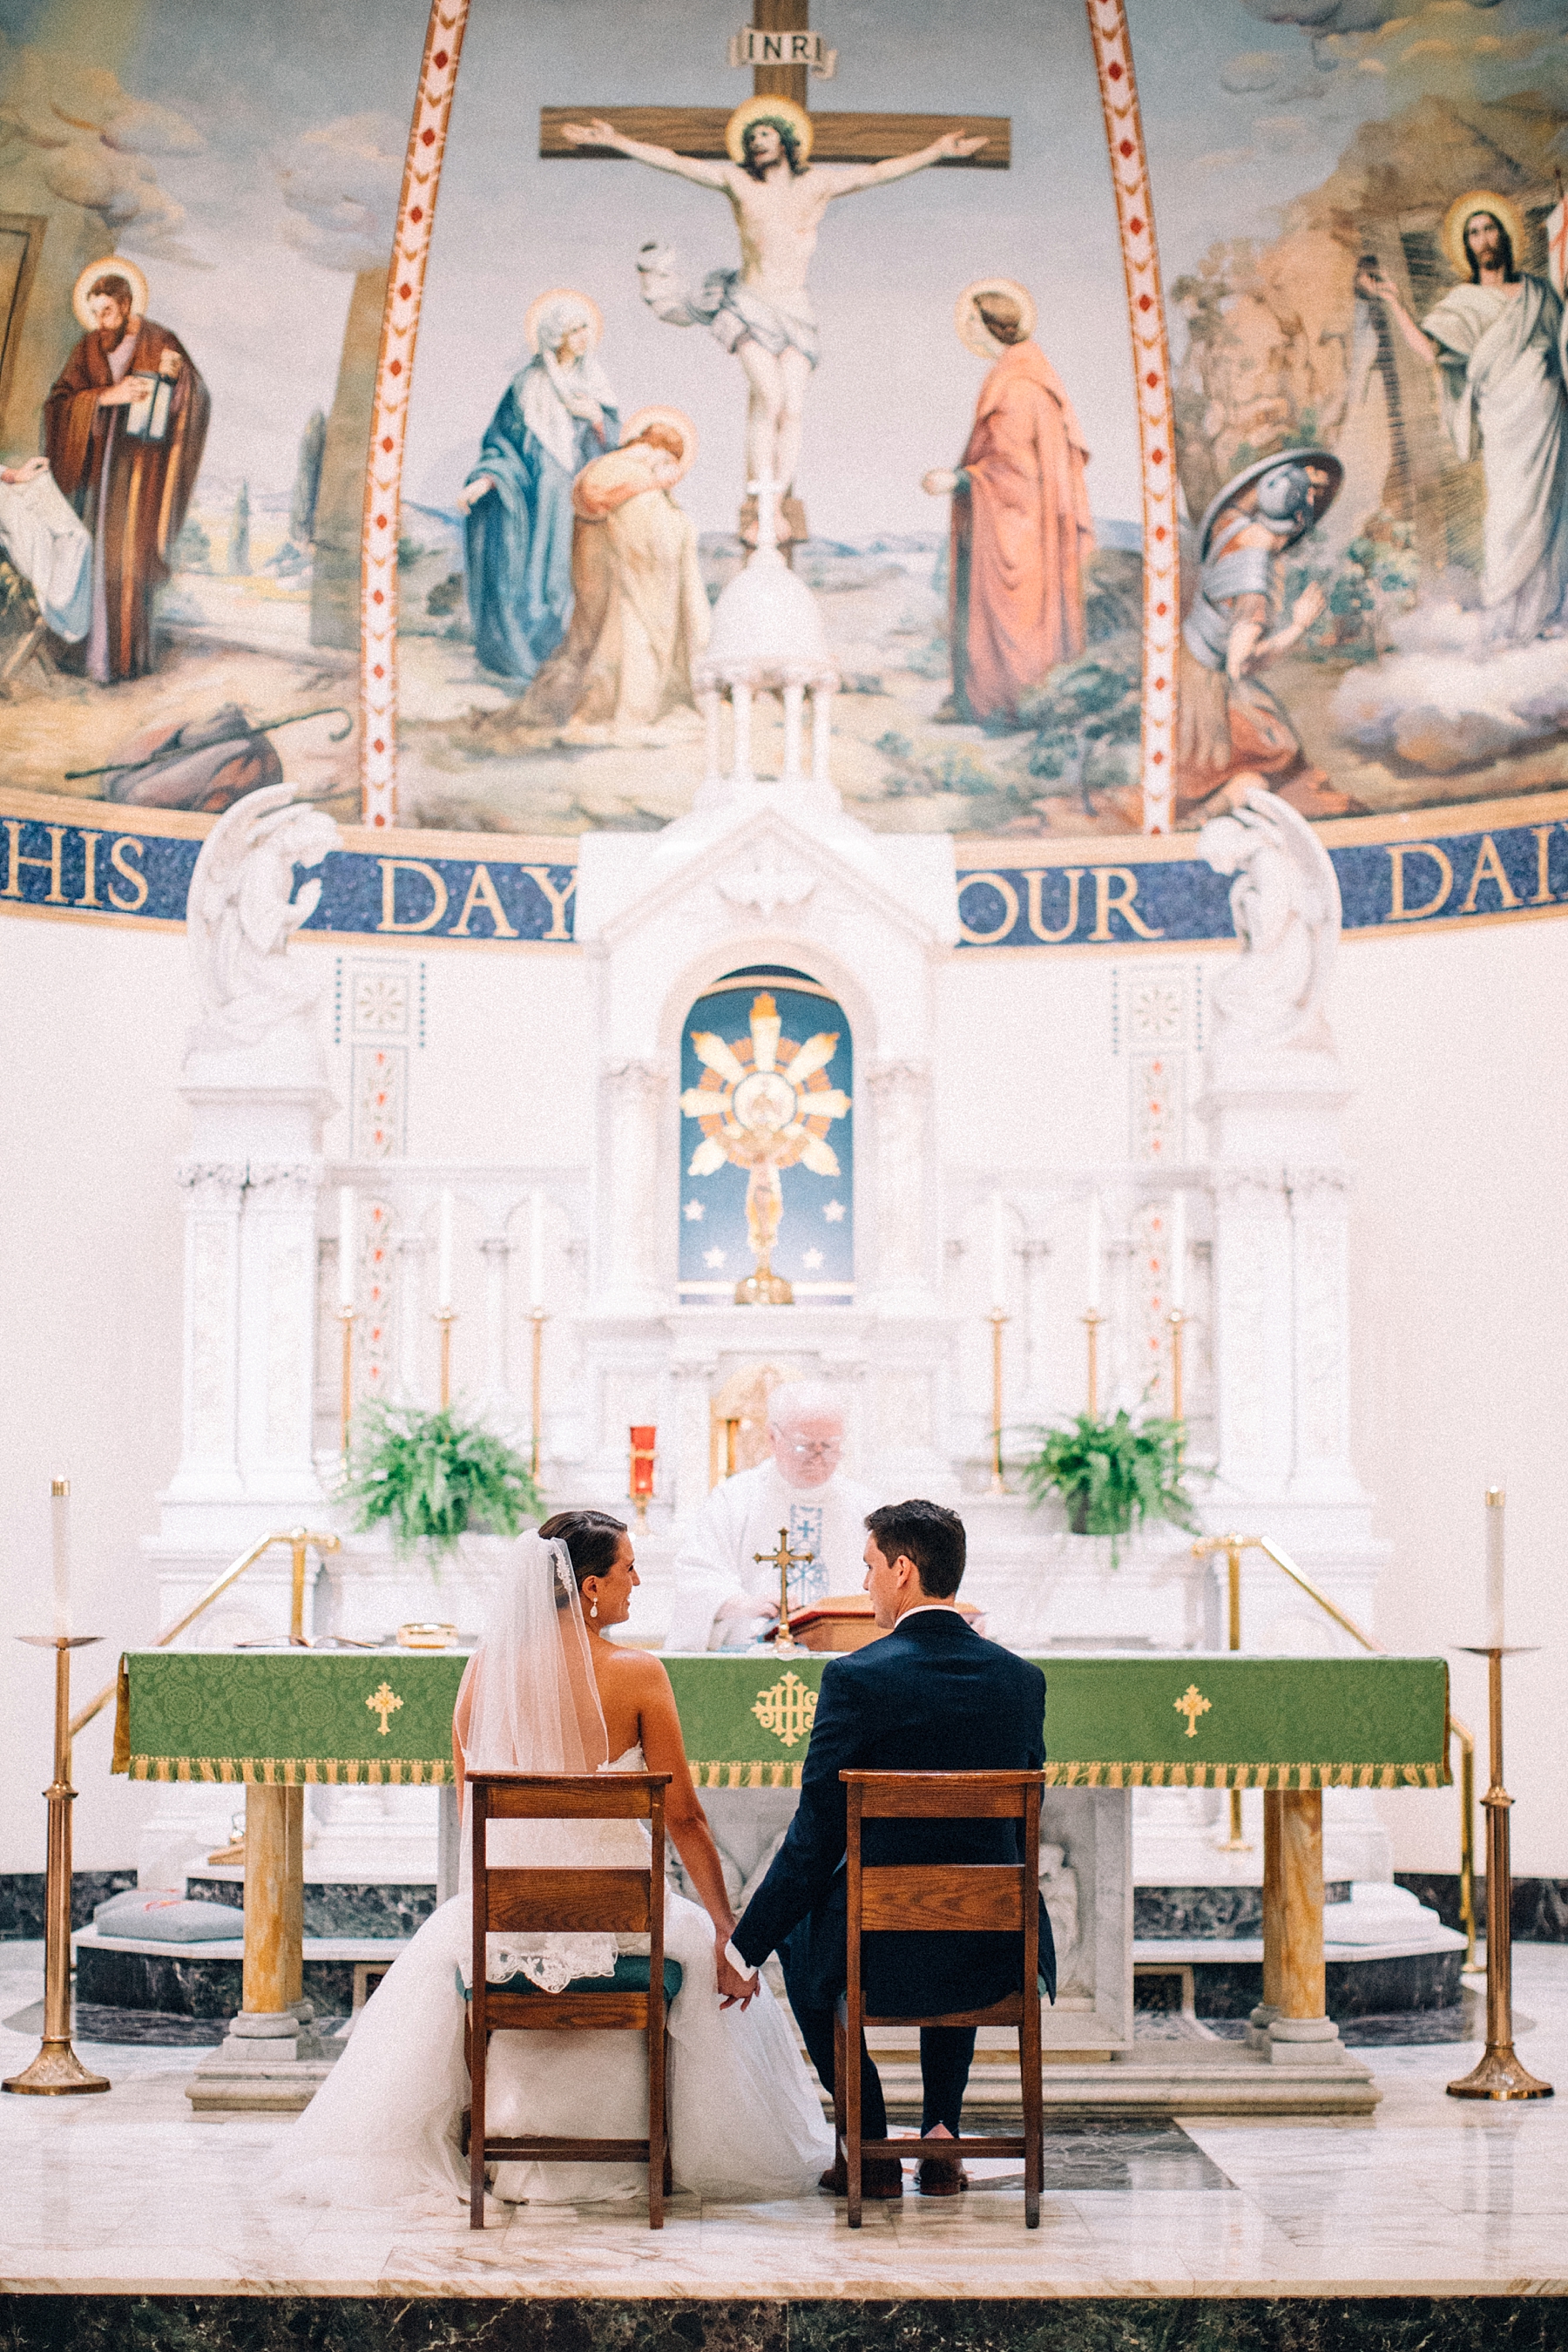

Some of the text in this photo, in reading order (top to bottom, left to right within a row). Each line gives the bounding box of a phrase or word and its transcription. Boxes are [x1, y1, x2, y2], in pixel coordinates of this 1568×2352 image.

[748, 33, 821, 61] INRI
[376, 858, 578, 940] DAY
[956, 867, 1166, 945] OUR
[1385, 822, 1568, 921] DAI
